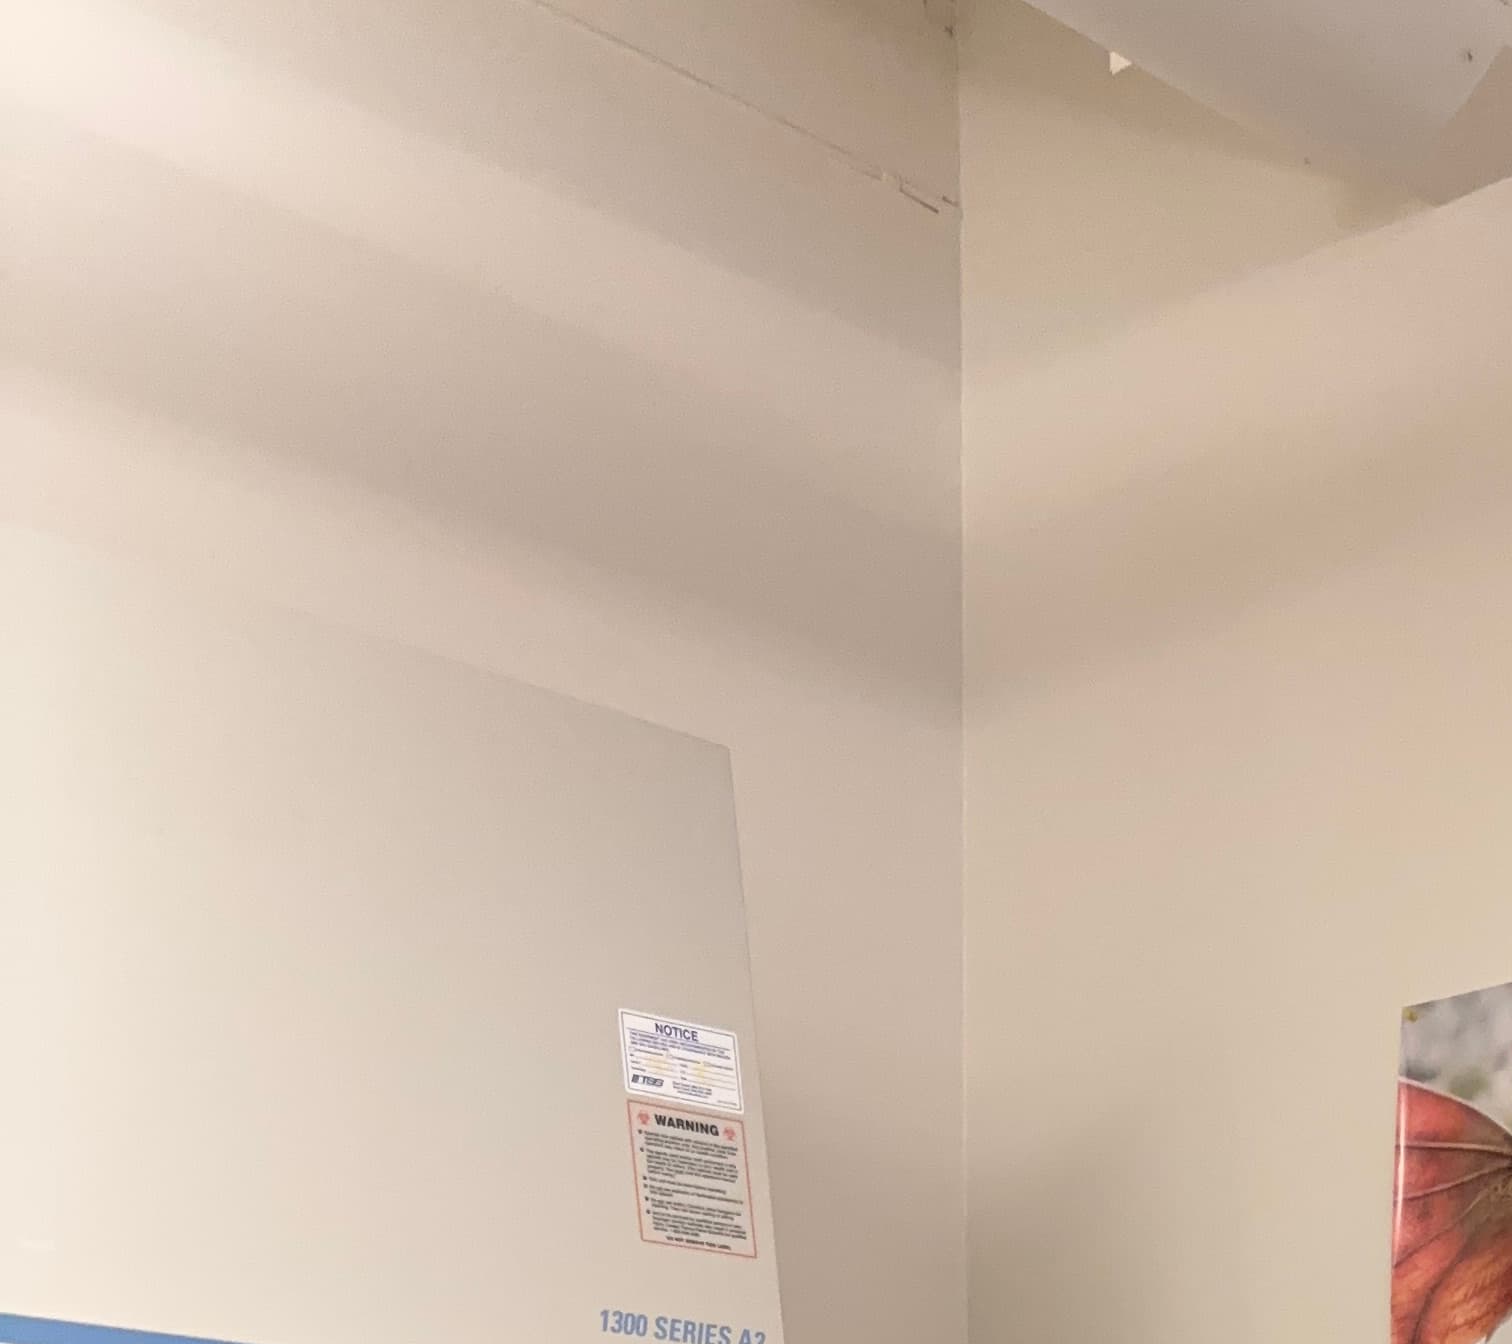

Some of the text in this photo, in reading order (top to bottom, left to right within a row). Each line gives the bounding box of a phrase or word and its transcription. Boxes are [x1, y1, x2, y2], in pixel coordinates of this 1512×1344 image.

[655, 1023, 699, 1042] NOTICE
[654, 1114, 720, 1136] WARNING
[600, 1309, 648, 1338] 1300
